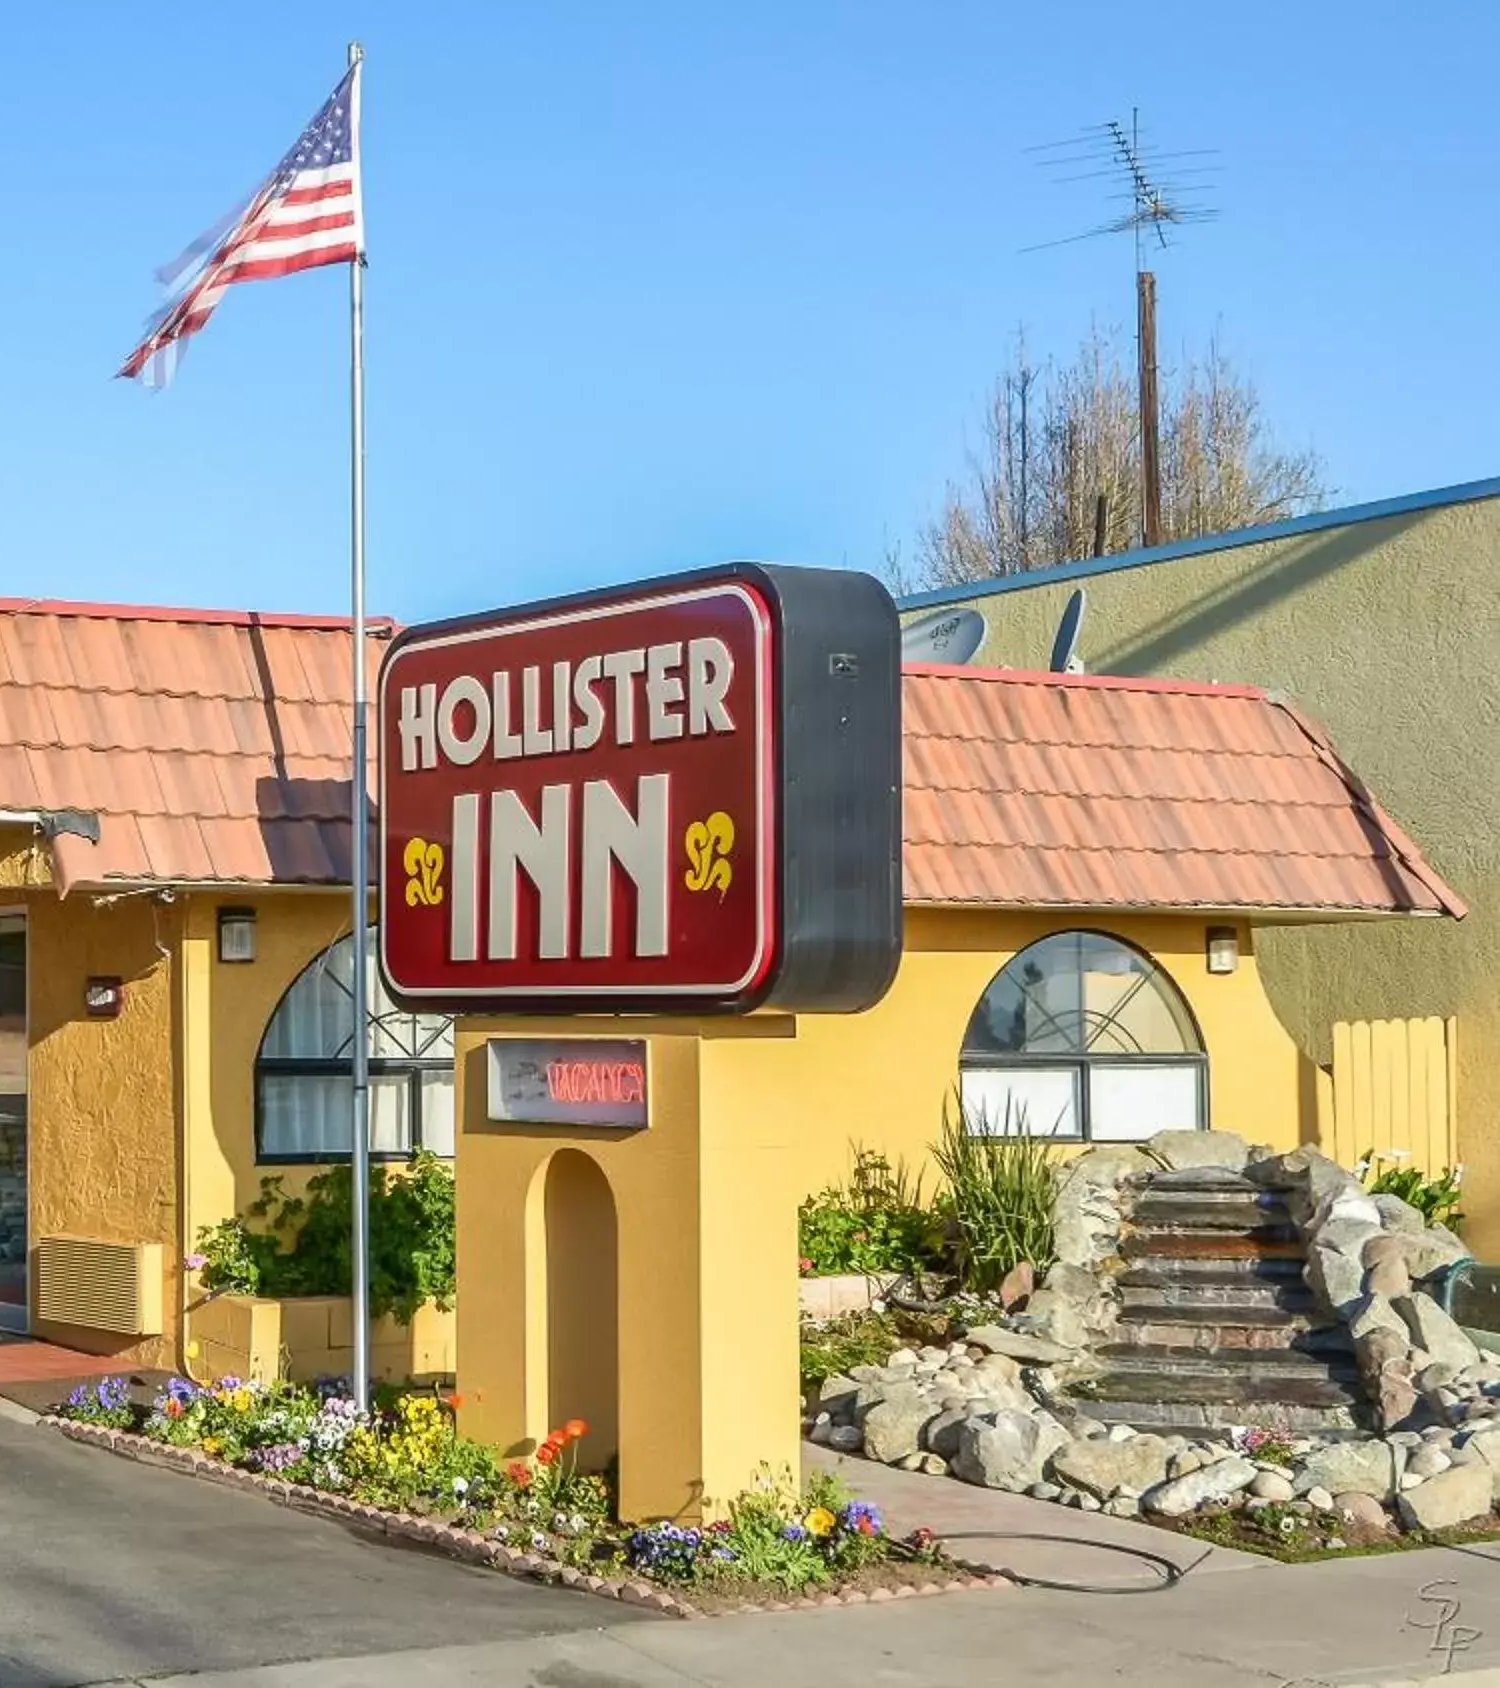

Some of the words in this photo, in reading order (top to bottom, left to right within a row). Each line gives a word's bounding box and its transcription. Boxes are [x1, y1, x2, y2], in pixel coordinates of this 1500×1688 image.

[398, 636, 736, 771] HOLLISTER
[450, 773, 669, 962] INN
[546, 1060, 645, 1104] VACANCY
